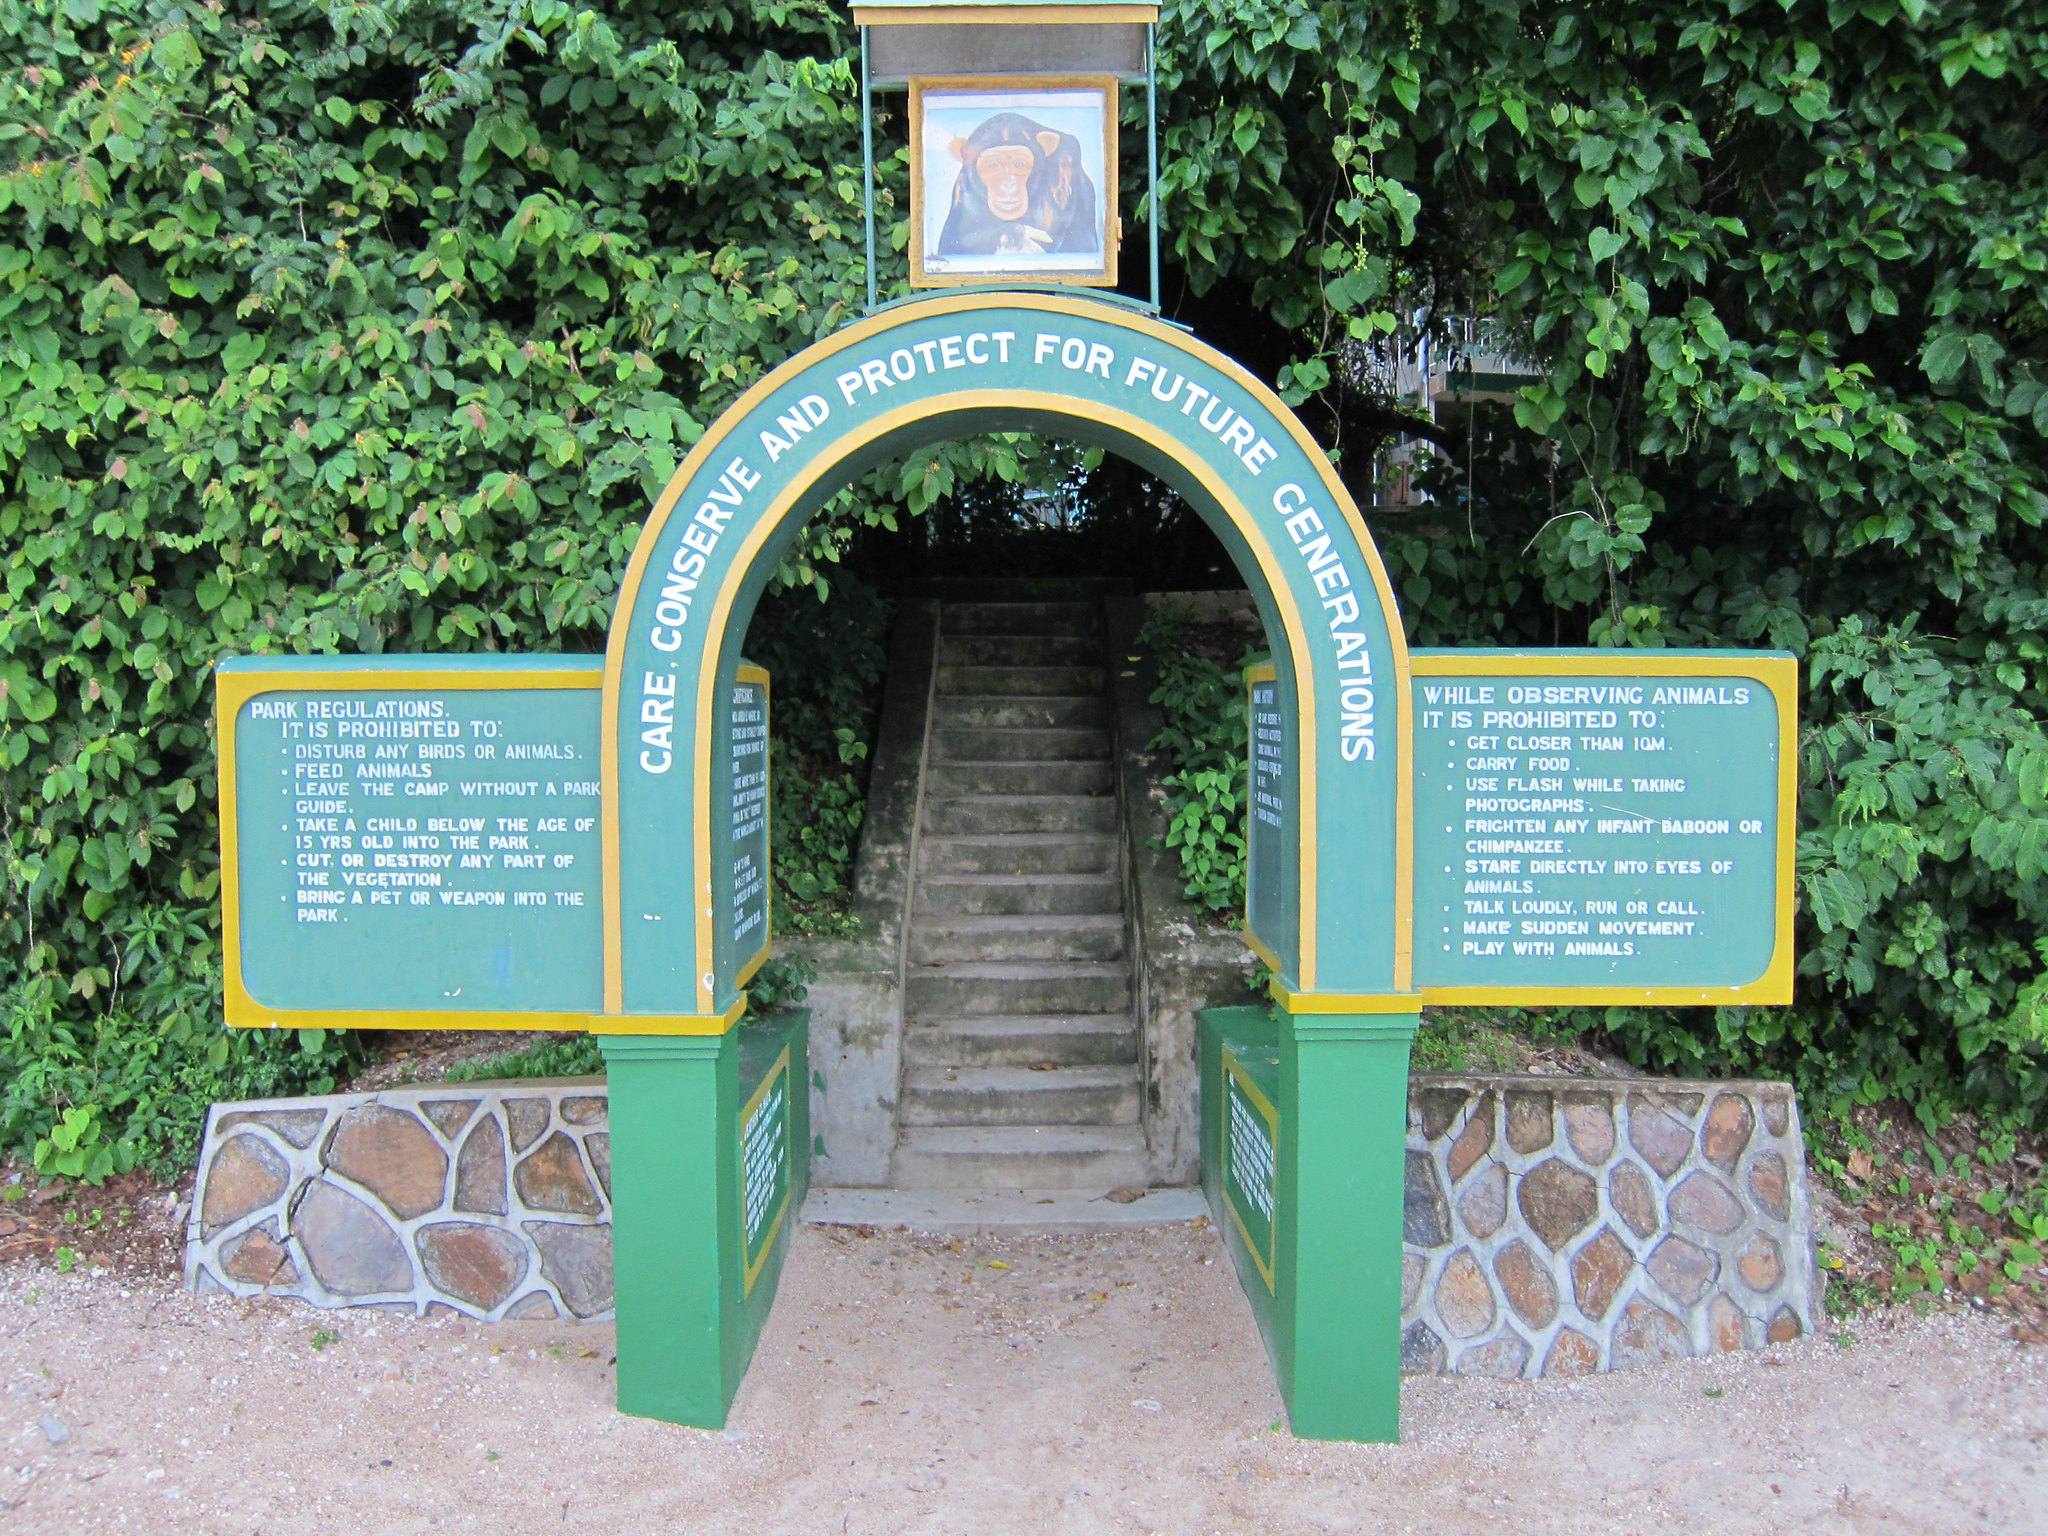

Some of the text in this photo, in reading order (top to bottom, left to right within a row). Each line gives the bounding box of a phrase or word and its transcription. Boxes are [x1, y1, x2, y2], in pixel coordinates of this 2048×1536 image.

[650, 456, 762, 652] CONSERVE
[758, 394, 832, 464] AND
[836, 330, 1015, 407] PROTECT
[1033, 334, 1115, 380] FOR
[1124, 357, 1279, 477] FUTURE
[1271, 483, 1376, 763] GENERATIONS
[1423, 686, 1750, 705] WHILE OBSERVING ANIMALS
[251, 701, 451, 719] PARK REGULATIONS.
[1423, 710, 1665, 729] IT IS PROHIBITED TO:
[281, 721, 502, 738] IT IS PROHIBITED TO:
[1467, 736, 1499, 751] GET
[1507, 736, 1572, 751] CLOSER
[1580, 736, 1623, 751] THAN
[295, 744, 583, 759] DISTURB ANY BIRDS OR ANIMALS.
[295, 763, 432, 778] FEED ANIMALS
[1467, 757, 1517, 771] CARRY
[295, 782, 601, 796] LEAVE THE CAMP WITHOUT A PARK
[1466, 778, 1686, 793] USE FLASH WHILE TAKING
[296, 800, 354, 814] GUIDE.
[296, 818, 595, 832] TAKE A CHILD BELOW THE AGE OF
[1465, 820, 1762, 834] FRIGHTEN ANY INFANT BABOON OR
[295, 836, 313, 849] 15
[319, 836, 352, 849] YRS
[361, 836, 394, 849] OLD
[402, 836, 440, 849] INTO
[450, 836, 480, 849] THE
[341, 854, 364, 868] OR
[374, 854, 452, 868] DESTROY
[460, 854, 494, 868] ANY
[503, 854, 544, 868] PART
[553, 854, 574, 868] OF
[1465, 860, 1733, 875] STARE DIRECTLY INTO EYES OF
[297, 872, 329, 887] THE
[1464, 880, 1540, 895] ANIMALS.
[297, 891, 584, 906] BRING A PET OR WEAPON INTO THE
[1464, 901, 1704, 916] TALK LOUDLY, RUN OR CALL.
[1463, 921, 1512, 936] MAKE
[1521, 921, 1589, 936] SUDDEN
[1463, 941, 1640, 956] PLAY WITH ANIMALS.
